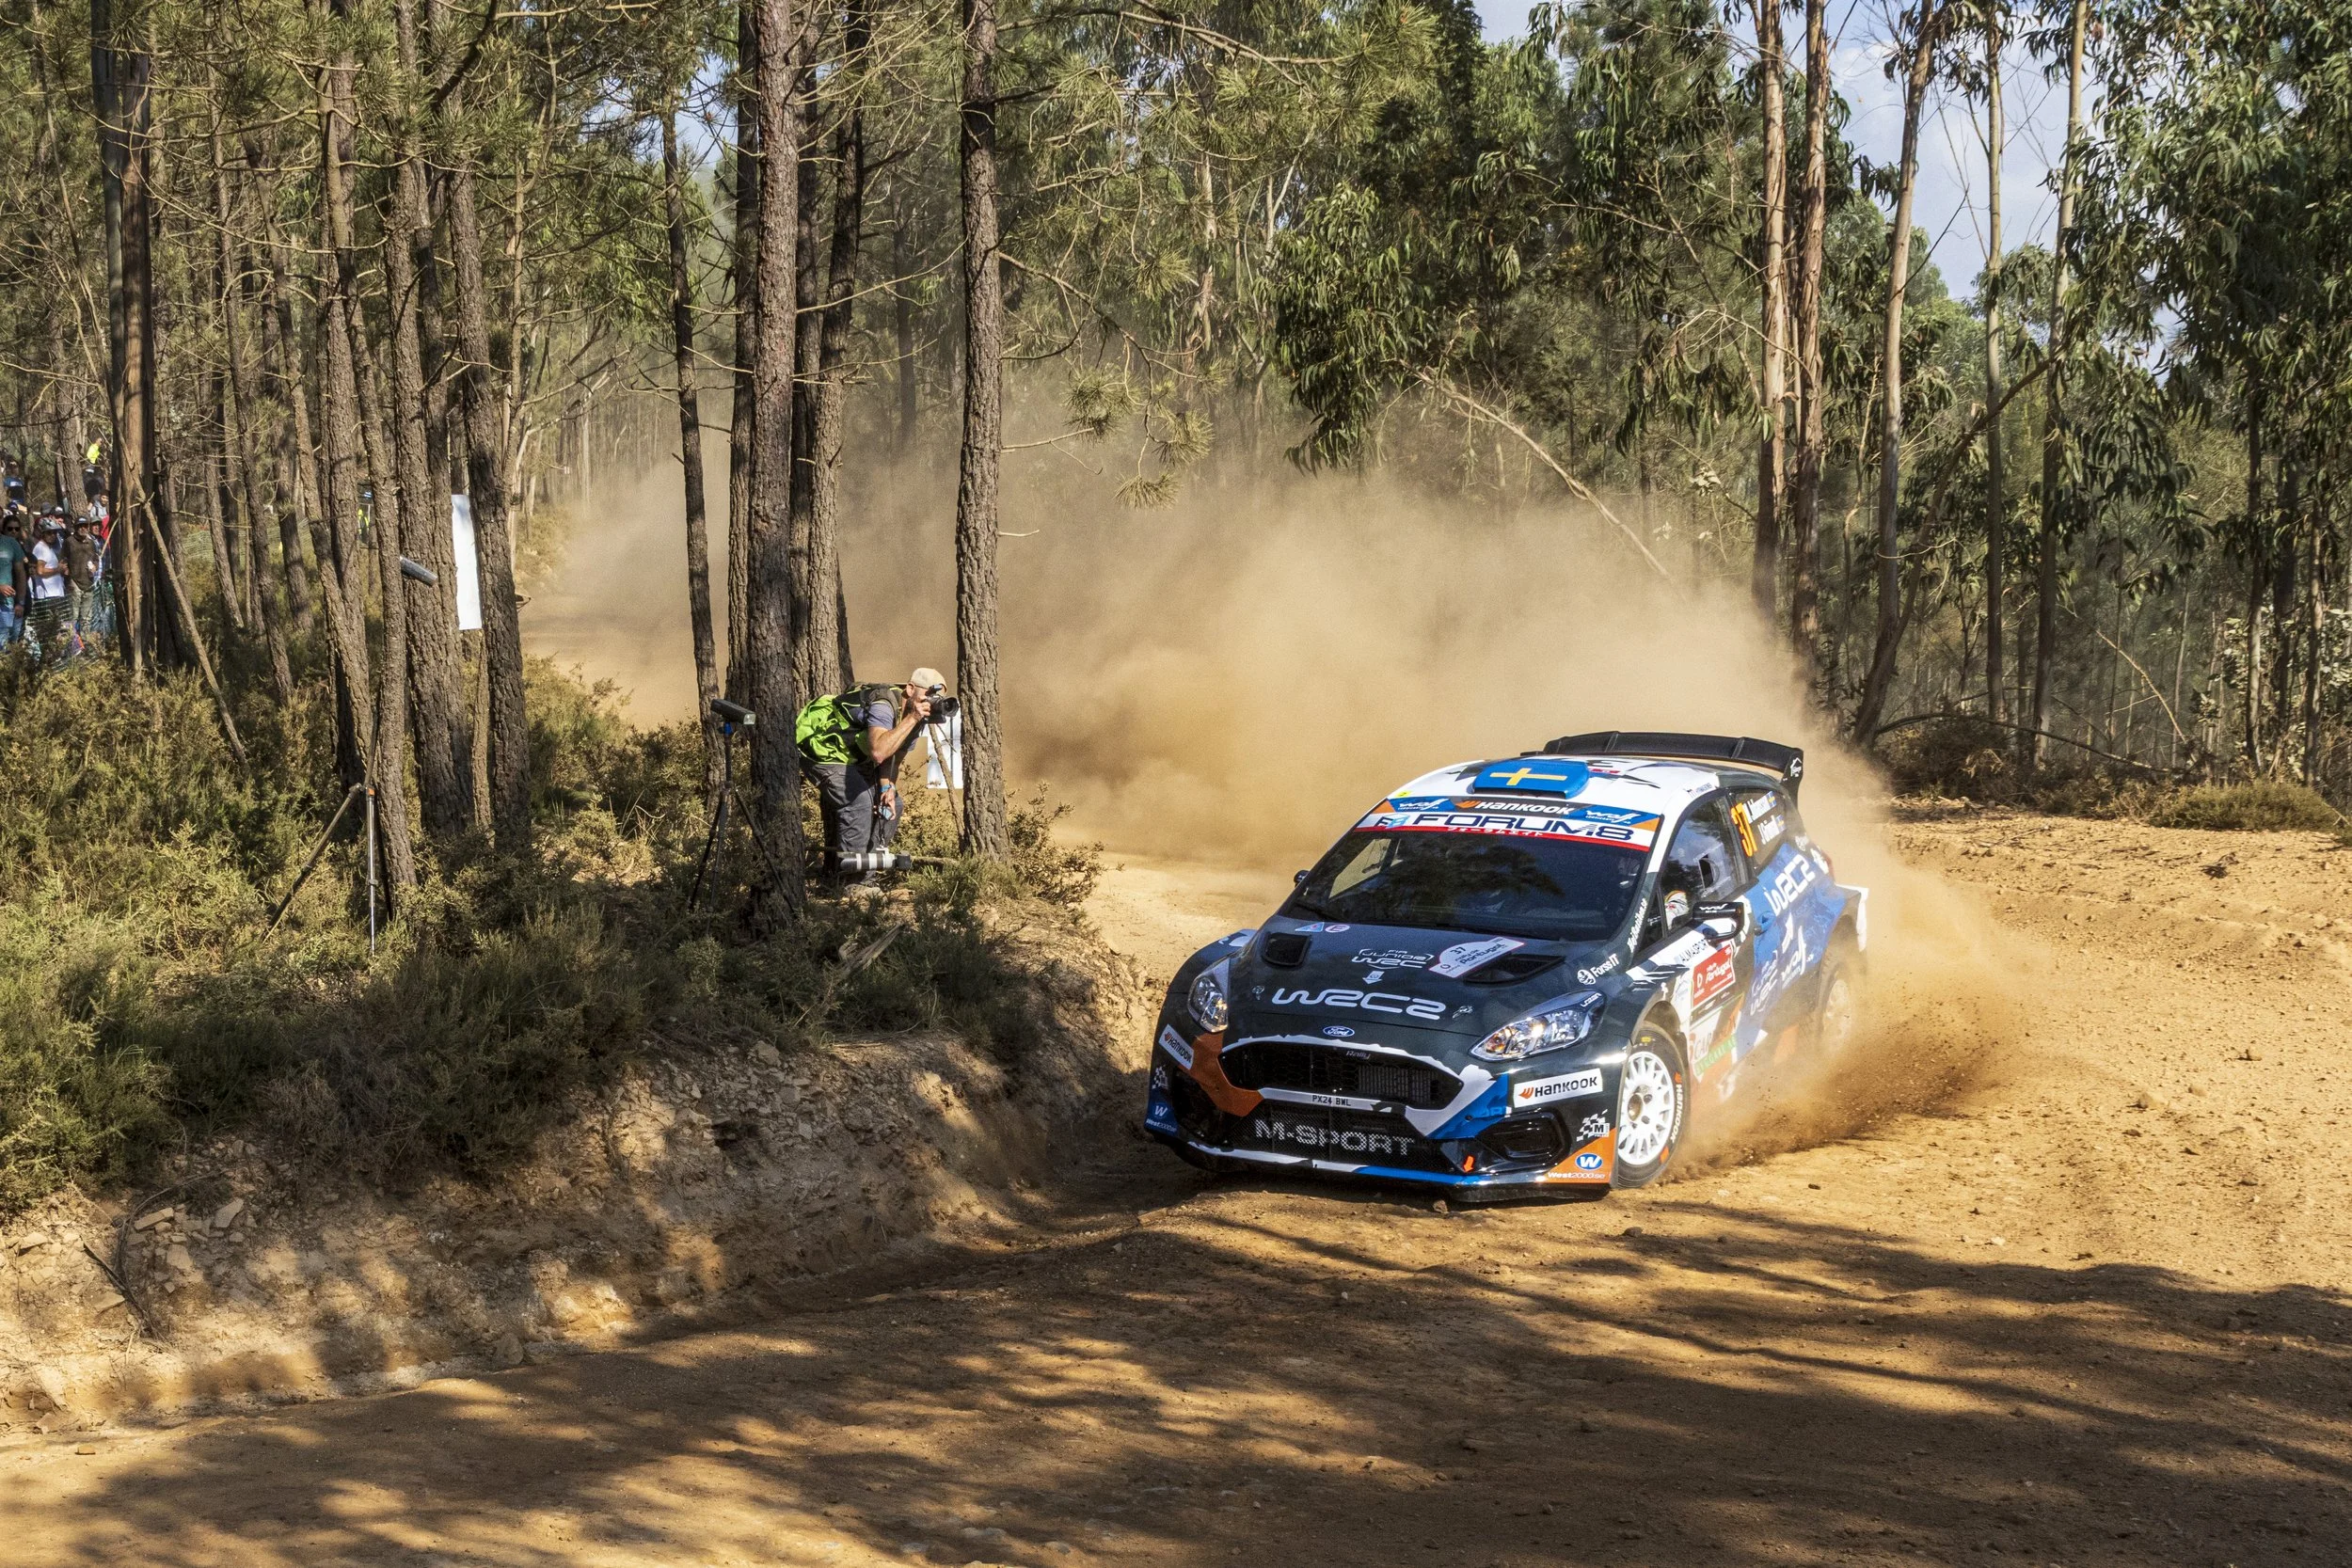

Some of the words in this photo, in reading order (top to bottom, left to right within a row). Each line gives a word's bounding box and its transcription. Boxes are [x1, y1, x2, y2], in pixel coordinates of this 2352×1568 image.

[1414, 814, 1634, 841] FORUM8
[1450, 946, 1466, 957] 37
[1351, 956, 1427, 969] WRC
[1271, 988, 1447, 1021] WRC2
[1327, 1025, 1350, 1036] Ford
[1311, 1094, 1333, 1105] PX24
[1335, 1098, 1352, 1107] BWL
[1154, 1105, 1168, 1117] W
[1255, 1119, 1415, 1156] M-SPORT
[1580, 1155, 1600, 1168] W
